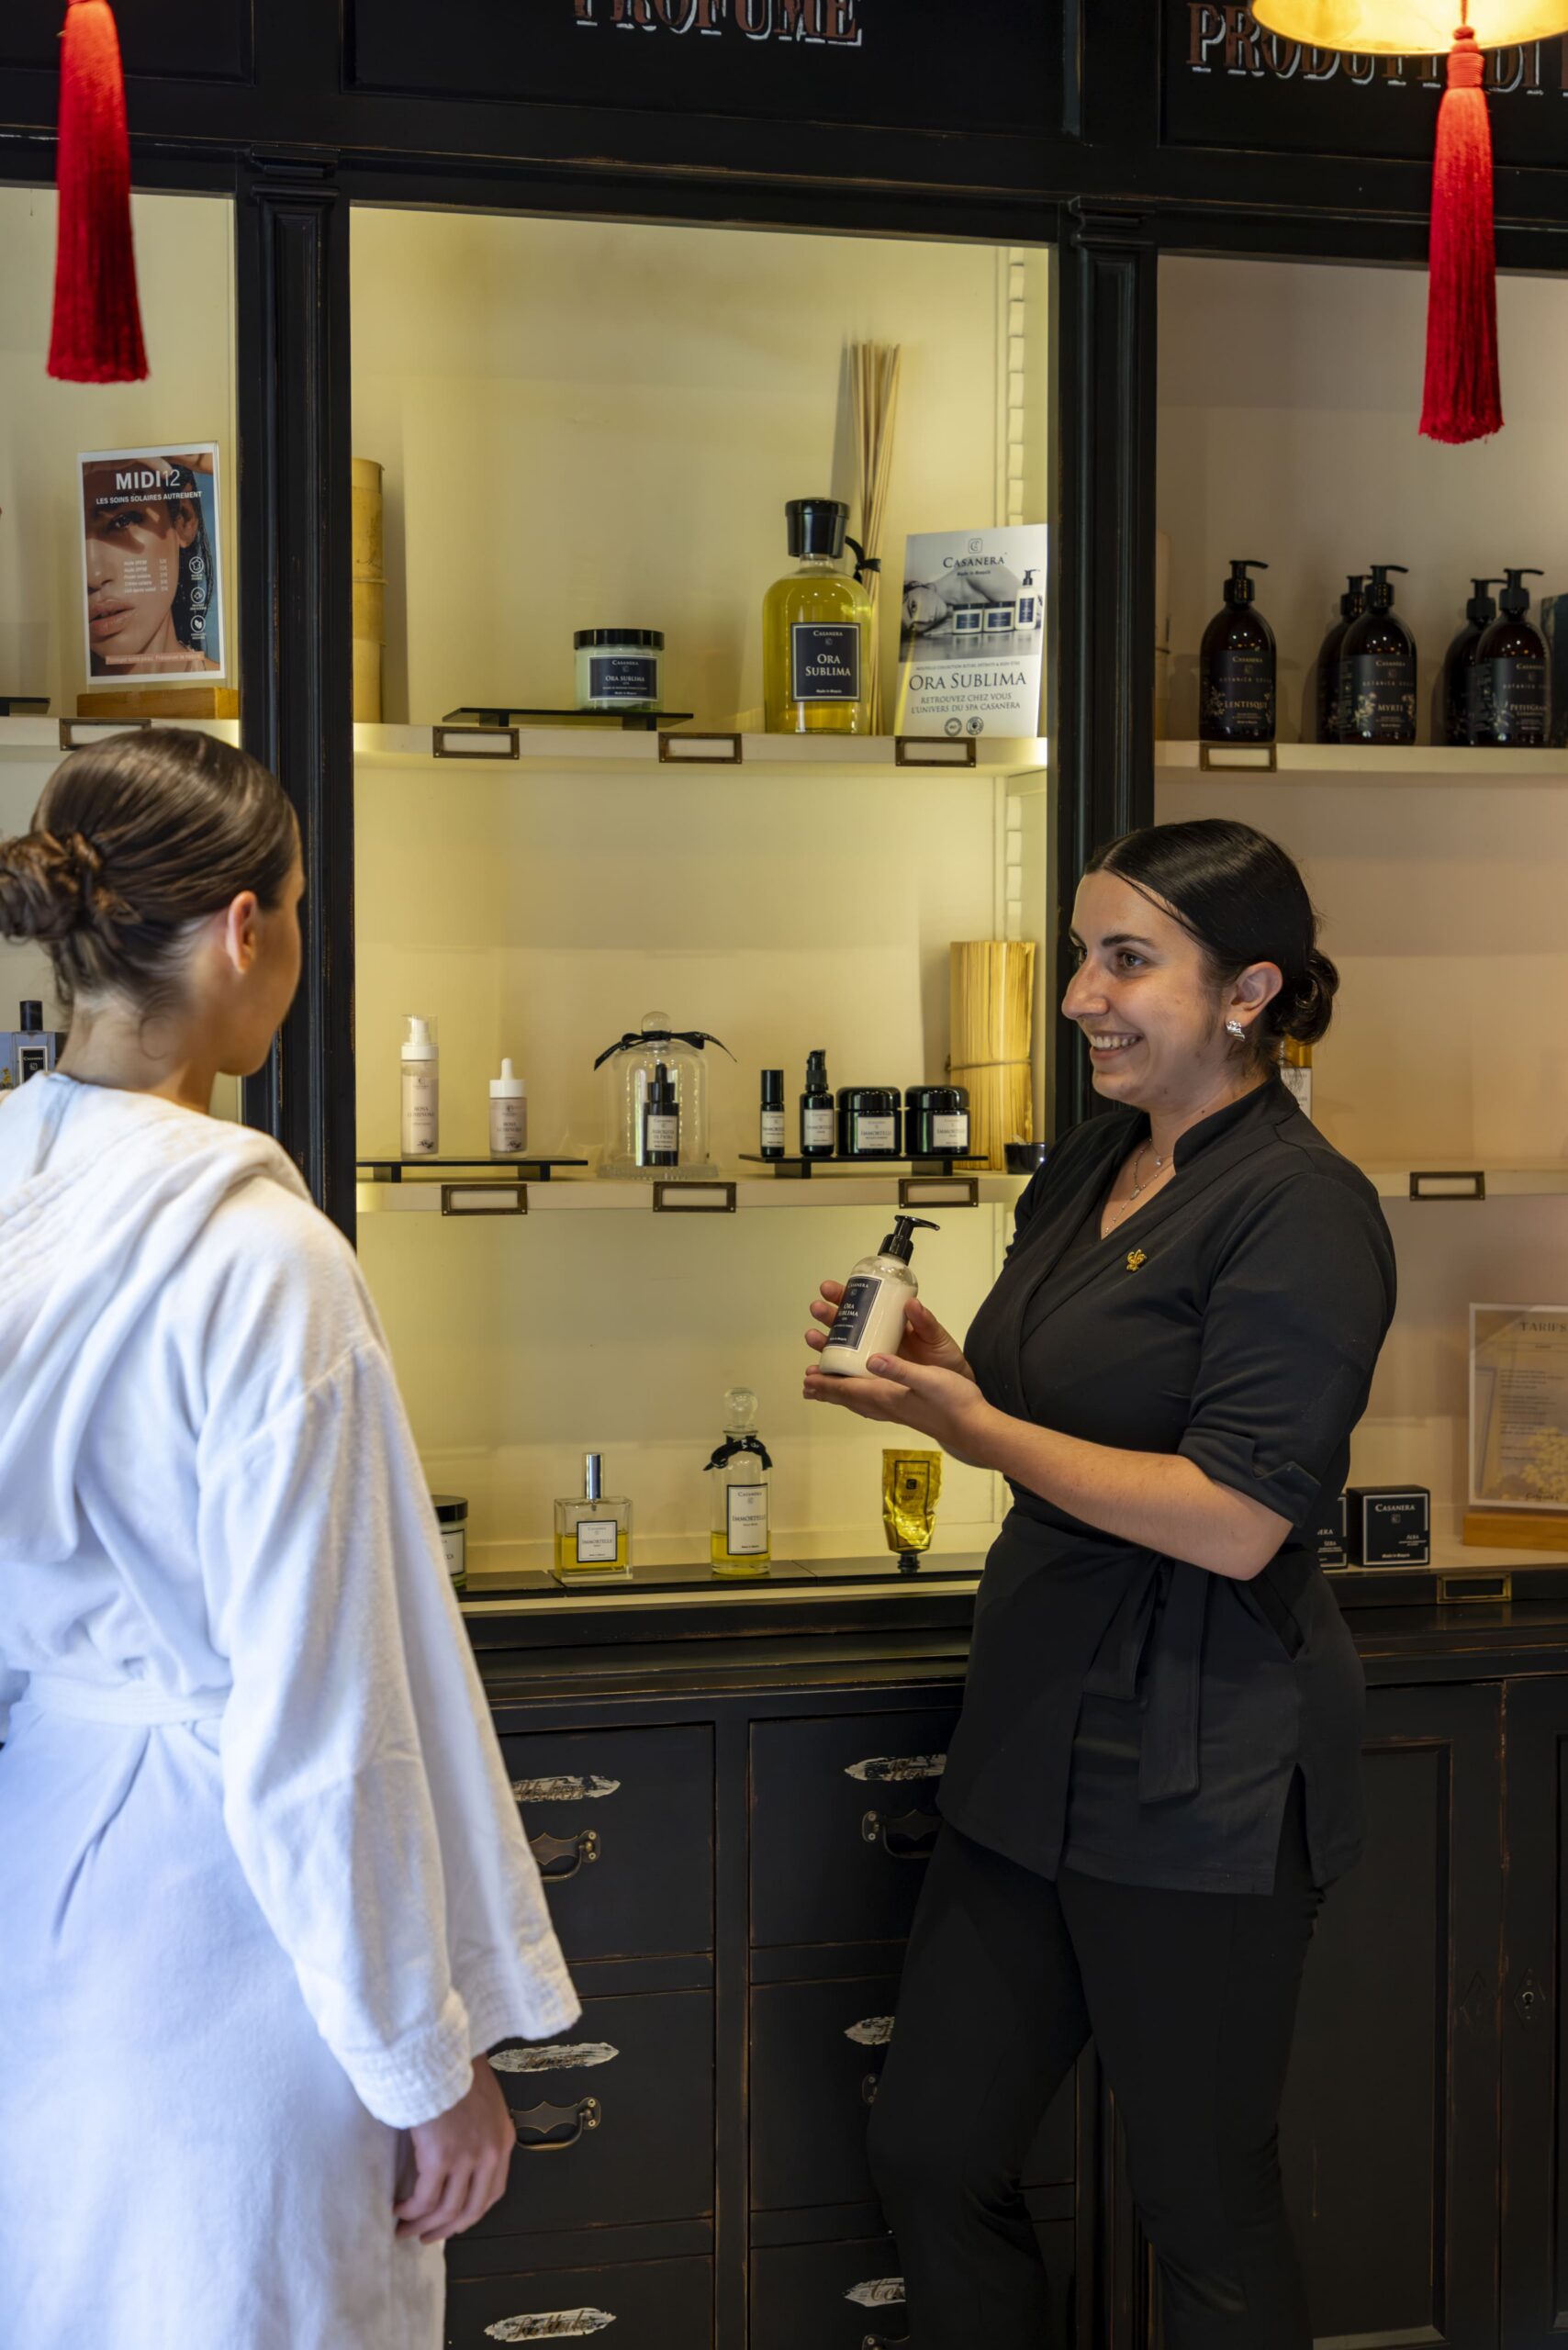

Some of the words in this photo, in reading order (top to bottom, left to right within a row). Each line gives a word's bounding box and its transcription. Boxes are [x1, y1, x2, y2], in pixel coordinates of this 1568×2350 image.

[130, 494, 162, 502] SOLAIRES
[163, 490, 203, 500] AUTREMENT
[817, 654, 841, 665] ORA
[805, 666, 852, 677] SUBLIMA
[909, 675, 946, 691] ORA
[950, 672, 1027, 689] SUBLIMA
[921, 695, 966, 704] RETROUVEZ
[967, 693, 989, 703] CHEZ
[990, 692, 1012, 700] VOUS
[951, 704, 964, 712] DU
[965, 703, 979, 711] SPA
[980, 701, 1021, 711] CASANERA
